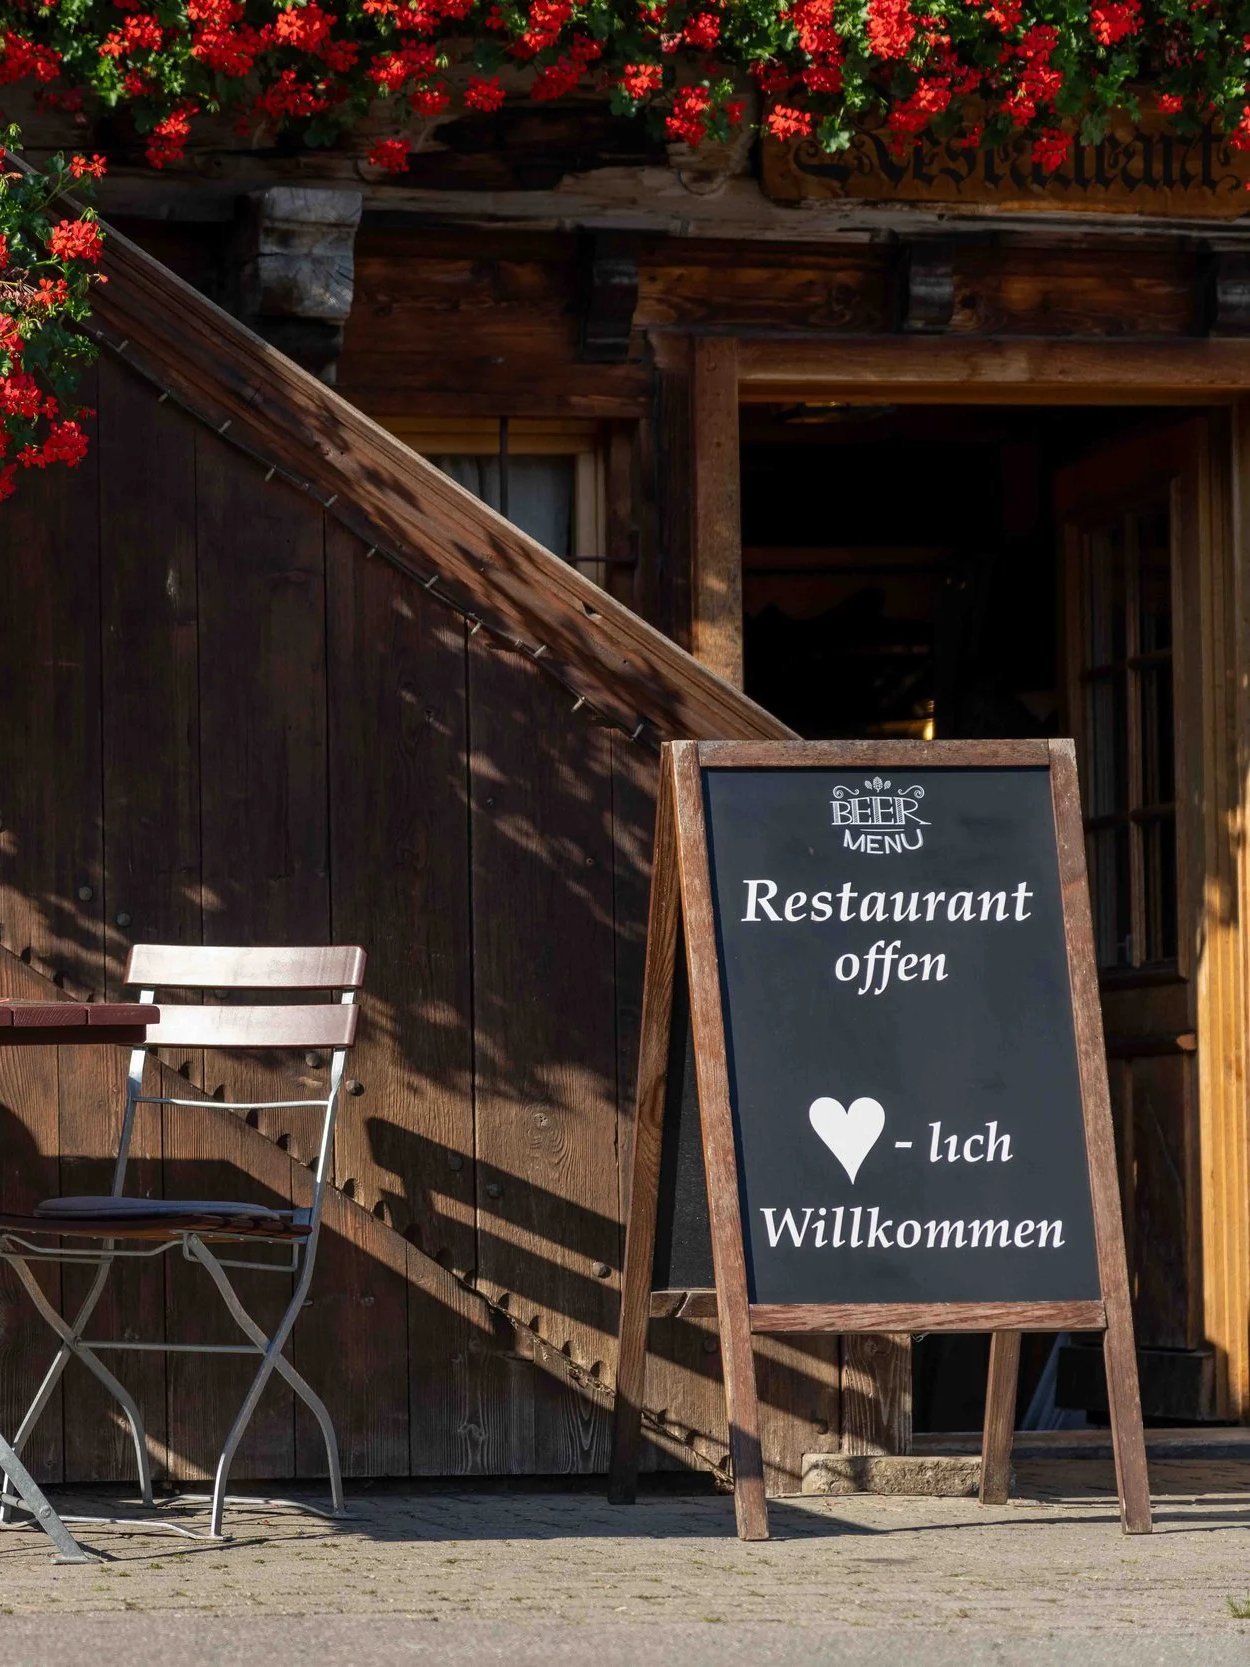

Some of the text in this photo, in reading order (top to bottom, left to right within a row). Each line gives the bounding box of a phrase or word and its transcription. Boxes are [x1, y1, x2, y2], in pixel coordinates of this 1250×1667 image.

[830, 796, 931, 825] BEER
[843, 828, 924, 854] MENU
[741, 880, 1033, 922] Restaurant
[835, 940, 948, 995] offen
[760, 1206, 1065, 1249] Willkommen
